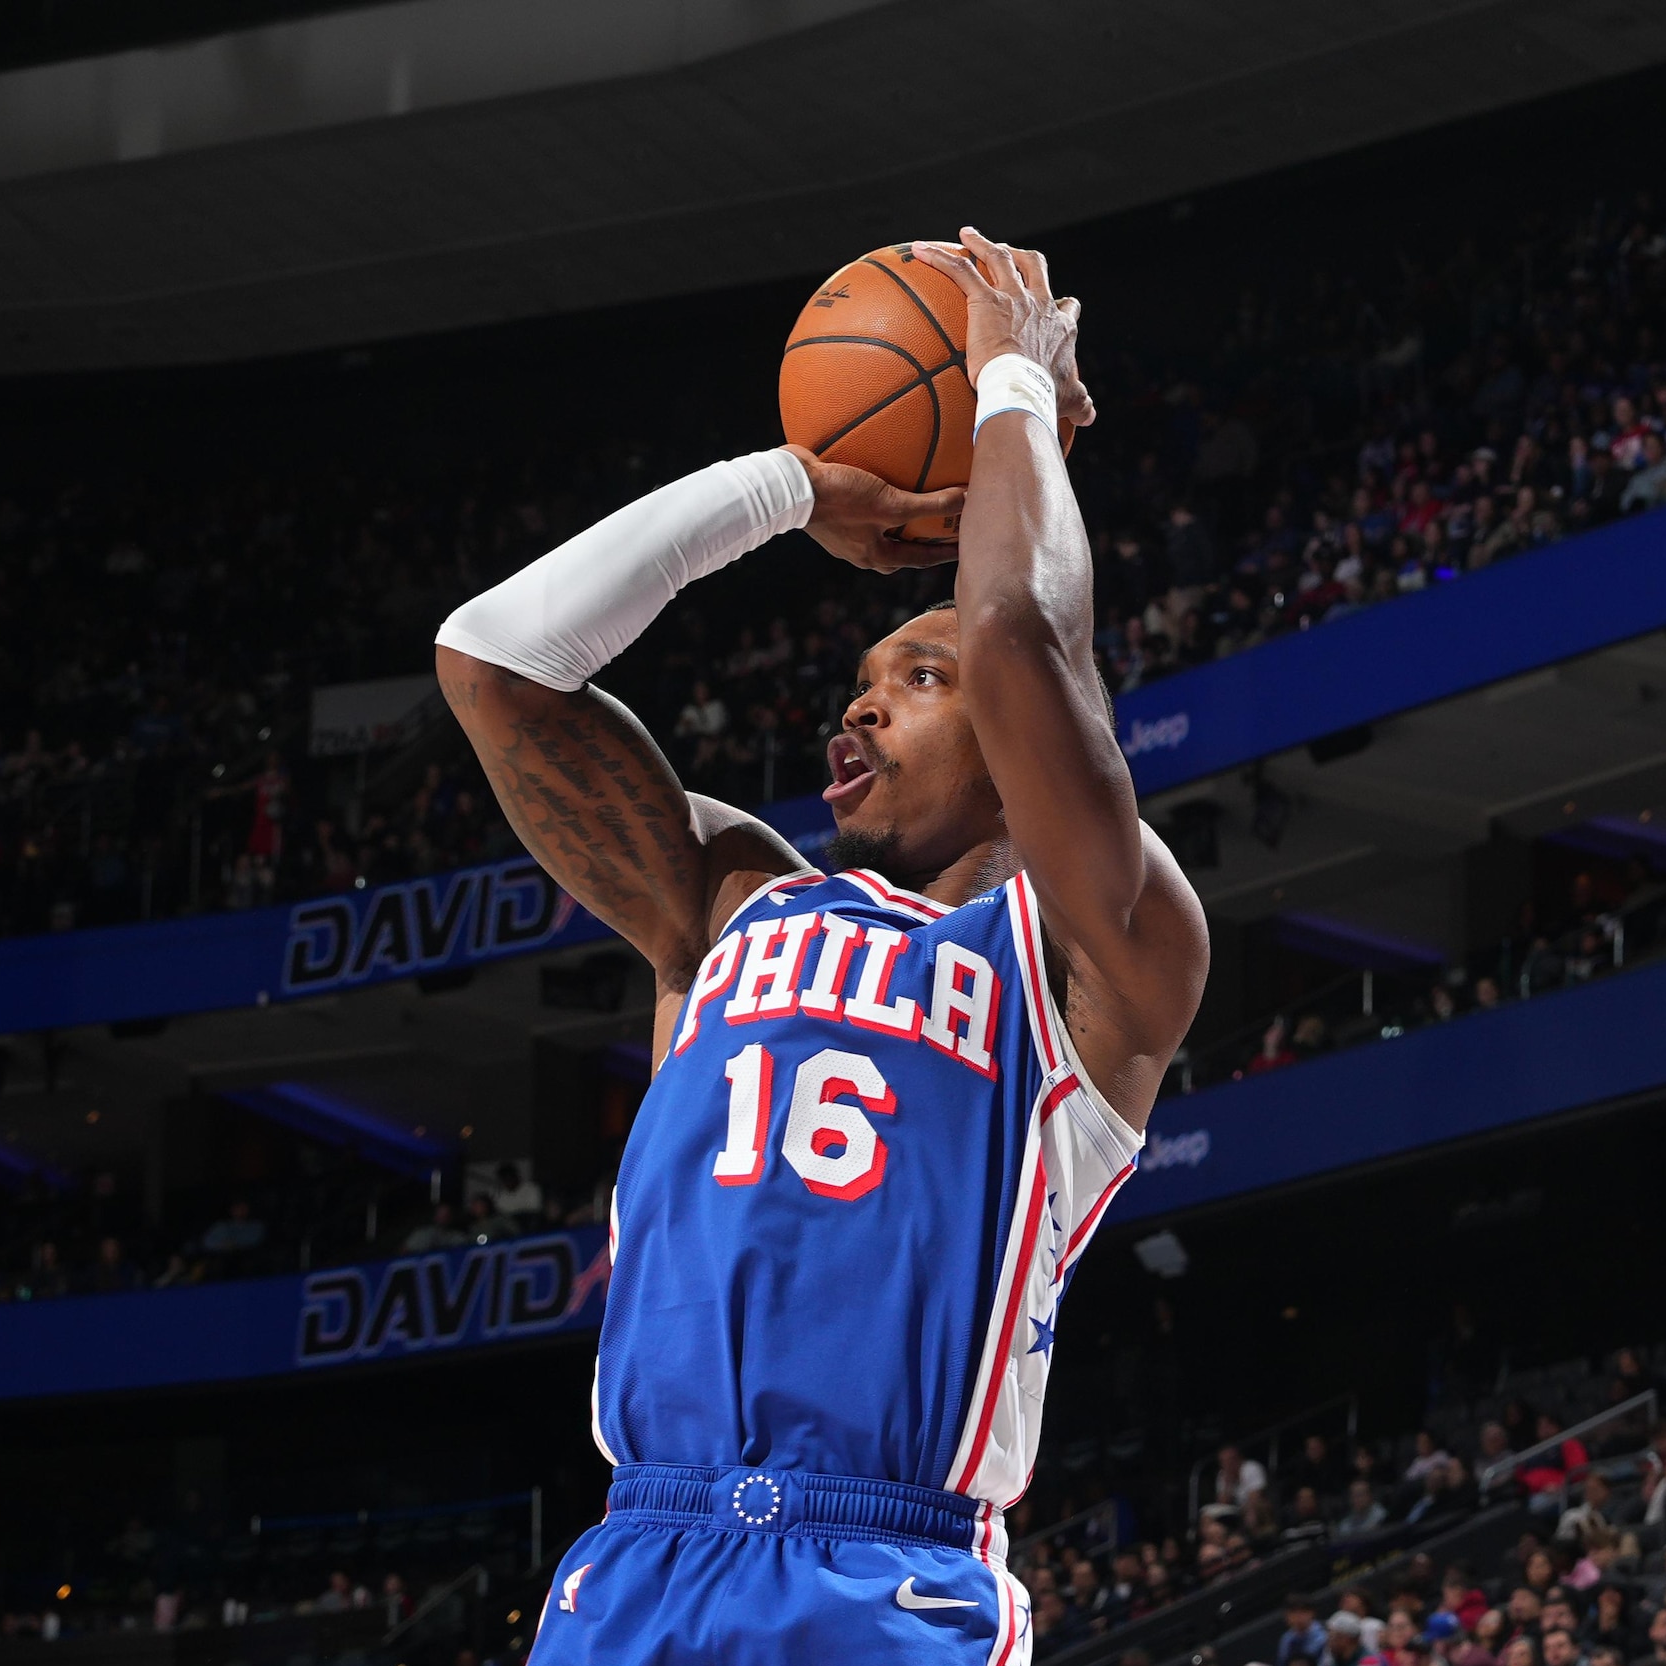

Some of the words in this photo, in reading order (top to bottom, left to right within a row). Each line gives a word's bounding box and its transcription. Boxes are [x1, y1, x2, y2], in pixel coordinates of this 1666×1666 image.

[282, 853, 561, 993] DAVID
[674, 911, 1003, 1083] PHILA
[713, 1042, 897, 1202] 16
[297, 1233, 580, 1367] DAVID
